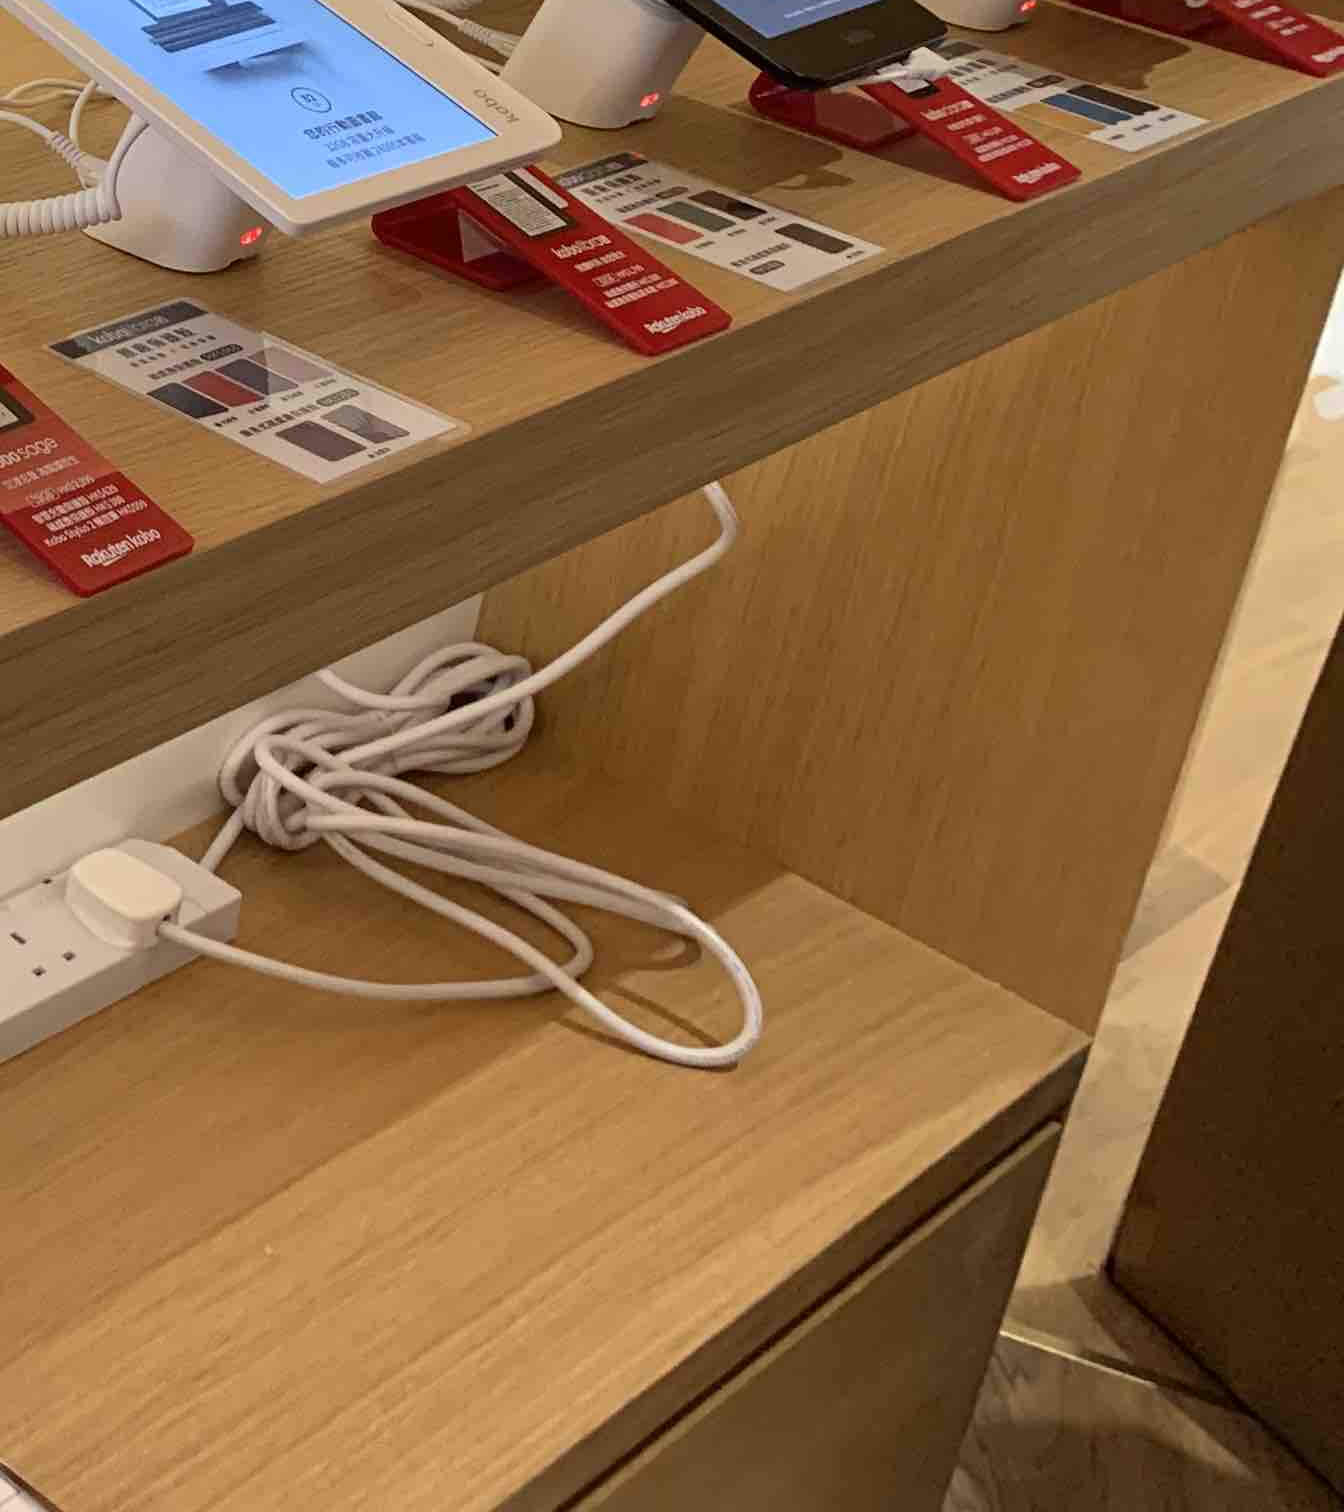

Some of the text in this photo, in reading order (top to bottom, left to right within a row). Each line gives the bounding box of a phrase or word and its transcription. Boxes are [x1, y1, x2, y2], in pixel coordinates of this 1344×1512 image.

[472, 88, 520, 125] kobo
[18, 437, 60, 461] sage
[80, 527, 162, 567] Rakuten kobo
